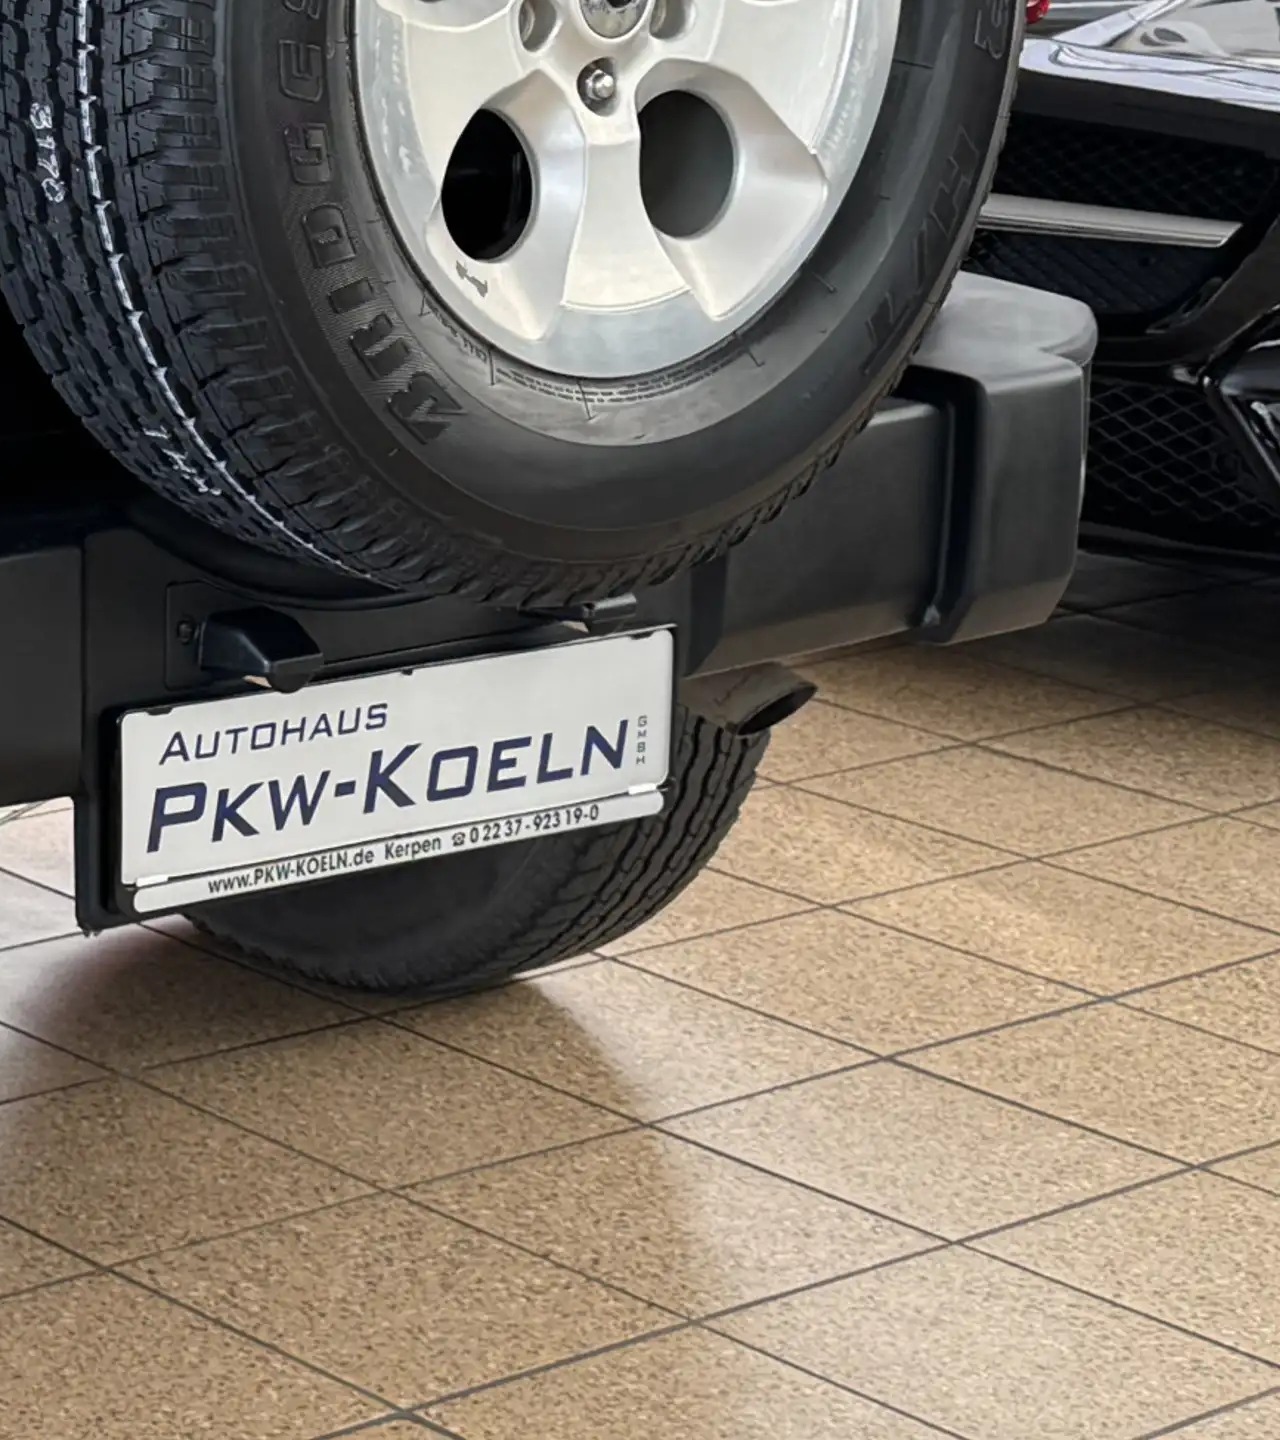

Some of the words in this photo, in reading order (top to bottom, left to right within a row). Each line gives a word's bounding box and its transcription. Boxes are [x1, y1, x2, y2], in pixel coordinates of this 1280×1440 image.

[158, 702, 389, 765] AUTOHAUS
[146, 718, 630, 853] PKW-KOELN
[207, 848, 375, 894] www.PKW-KOELN.de
[383, 837, 443, 860] Kerpen
